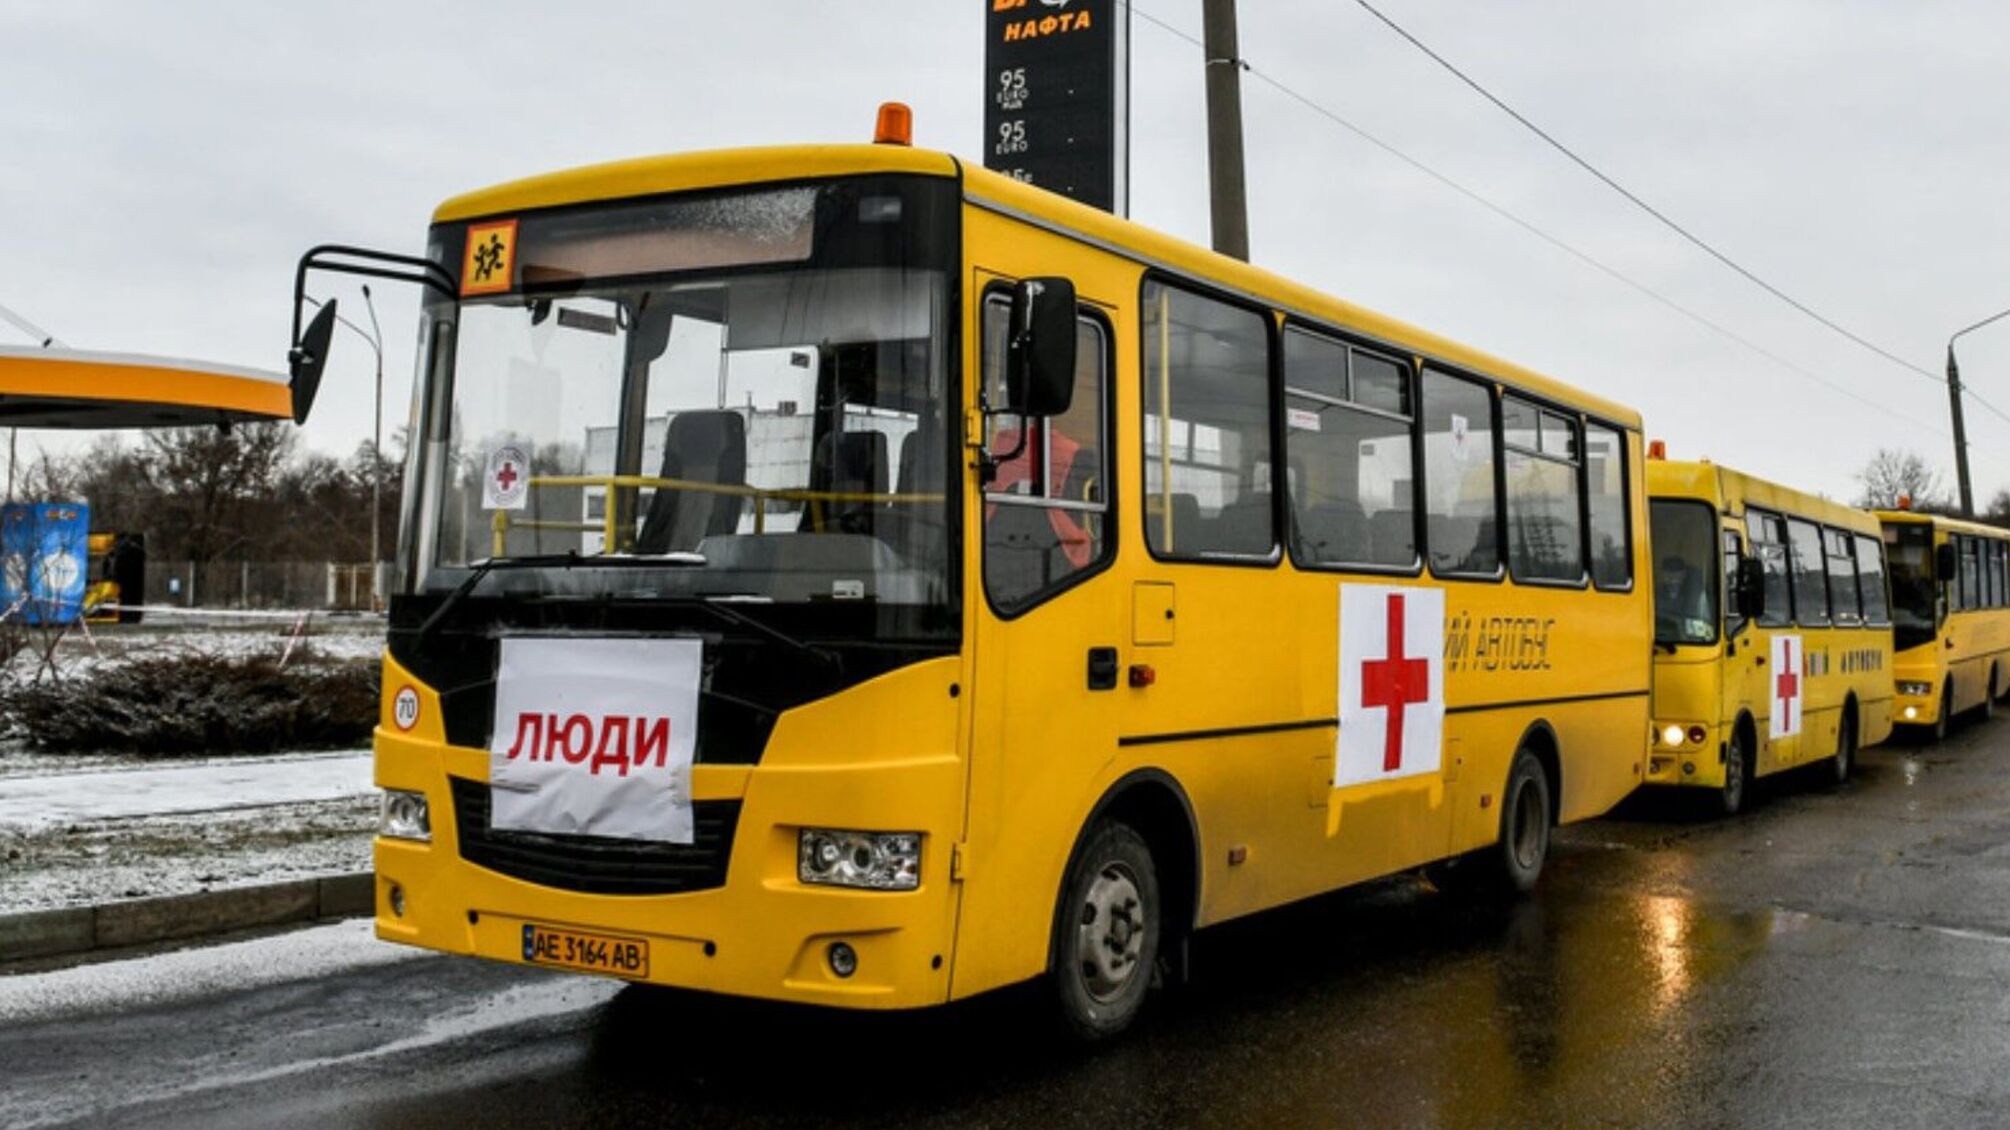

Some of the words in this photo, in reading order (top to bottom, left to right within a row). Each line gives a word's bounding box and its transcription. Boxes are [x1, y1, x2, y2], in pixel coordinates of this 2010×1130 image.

[1003, 10, 1091, 42] НАФТА
[1000, 69, 1025, 91] 95
[1000, 120, 1025, 142] 95
[1472, 616, 1556, 671] АВТОБУС
[399, 697, 416, 719] 70
[507, 712, 670, 777] ЛЮДИ
[535, 933, 560, 960] AE
[565, 936, 608, 966] 3164
[612, 943, 641, 970] AB
